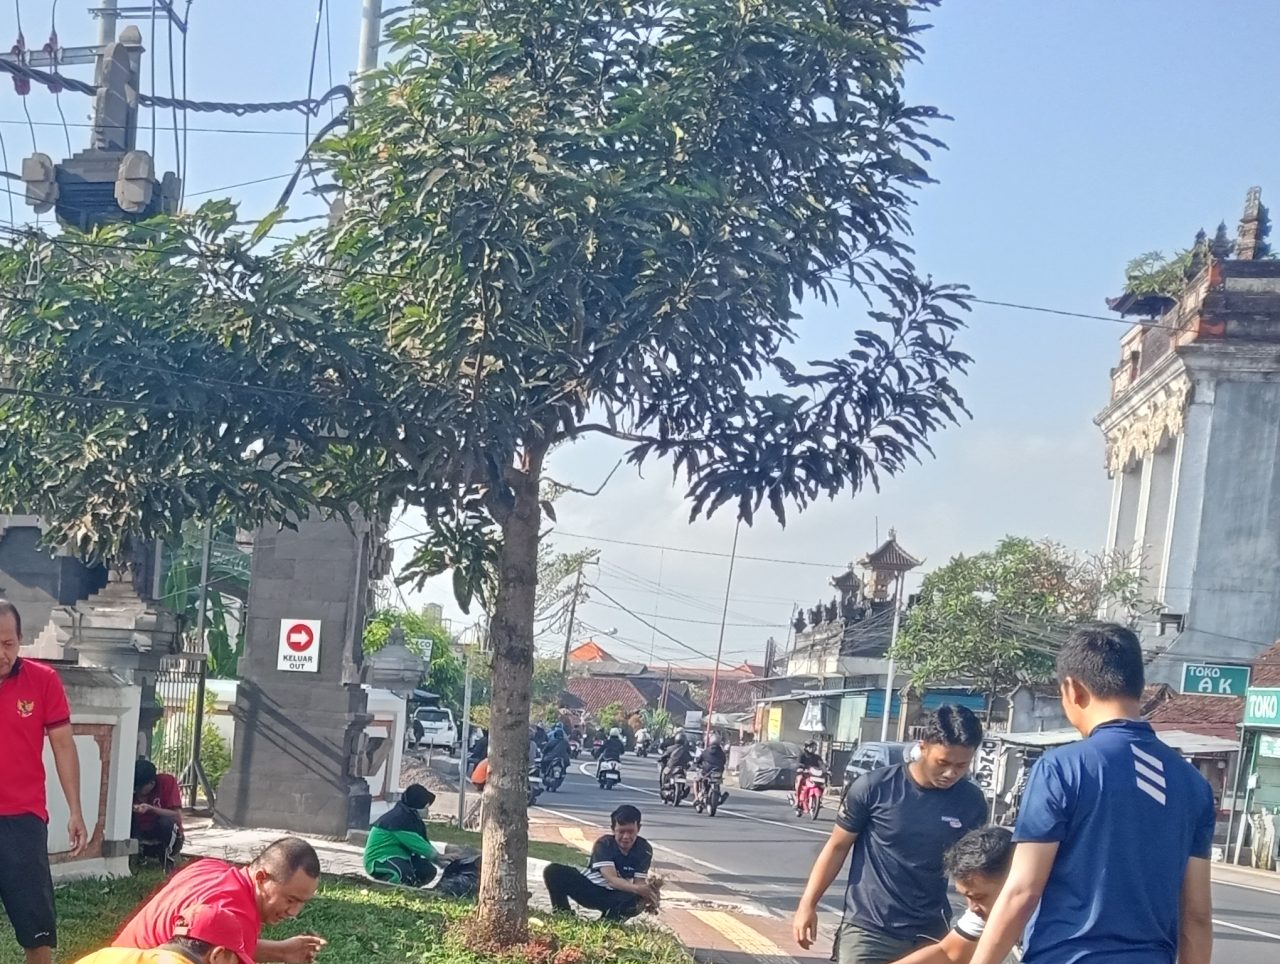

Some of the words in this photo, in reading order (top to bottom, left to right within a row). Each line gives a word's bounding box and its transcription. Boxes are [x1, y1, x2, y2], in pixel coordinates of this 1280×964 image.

[283, 655, 313, 663] KELUAR
[1188, 667, 1220, 677] TOKO
[1198, 677, 1212, 692] A
[1218, 678, 1232, 693] K
[1249, 695, 1278, 718] TOKO
[976, 741, 997, 787] DYNAMO
